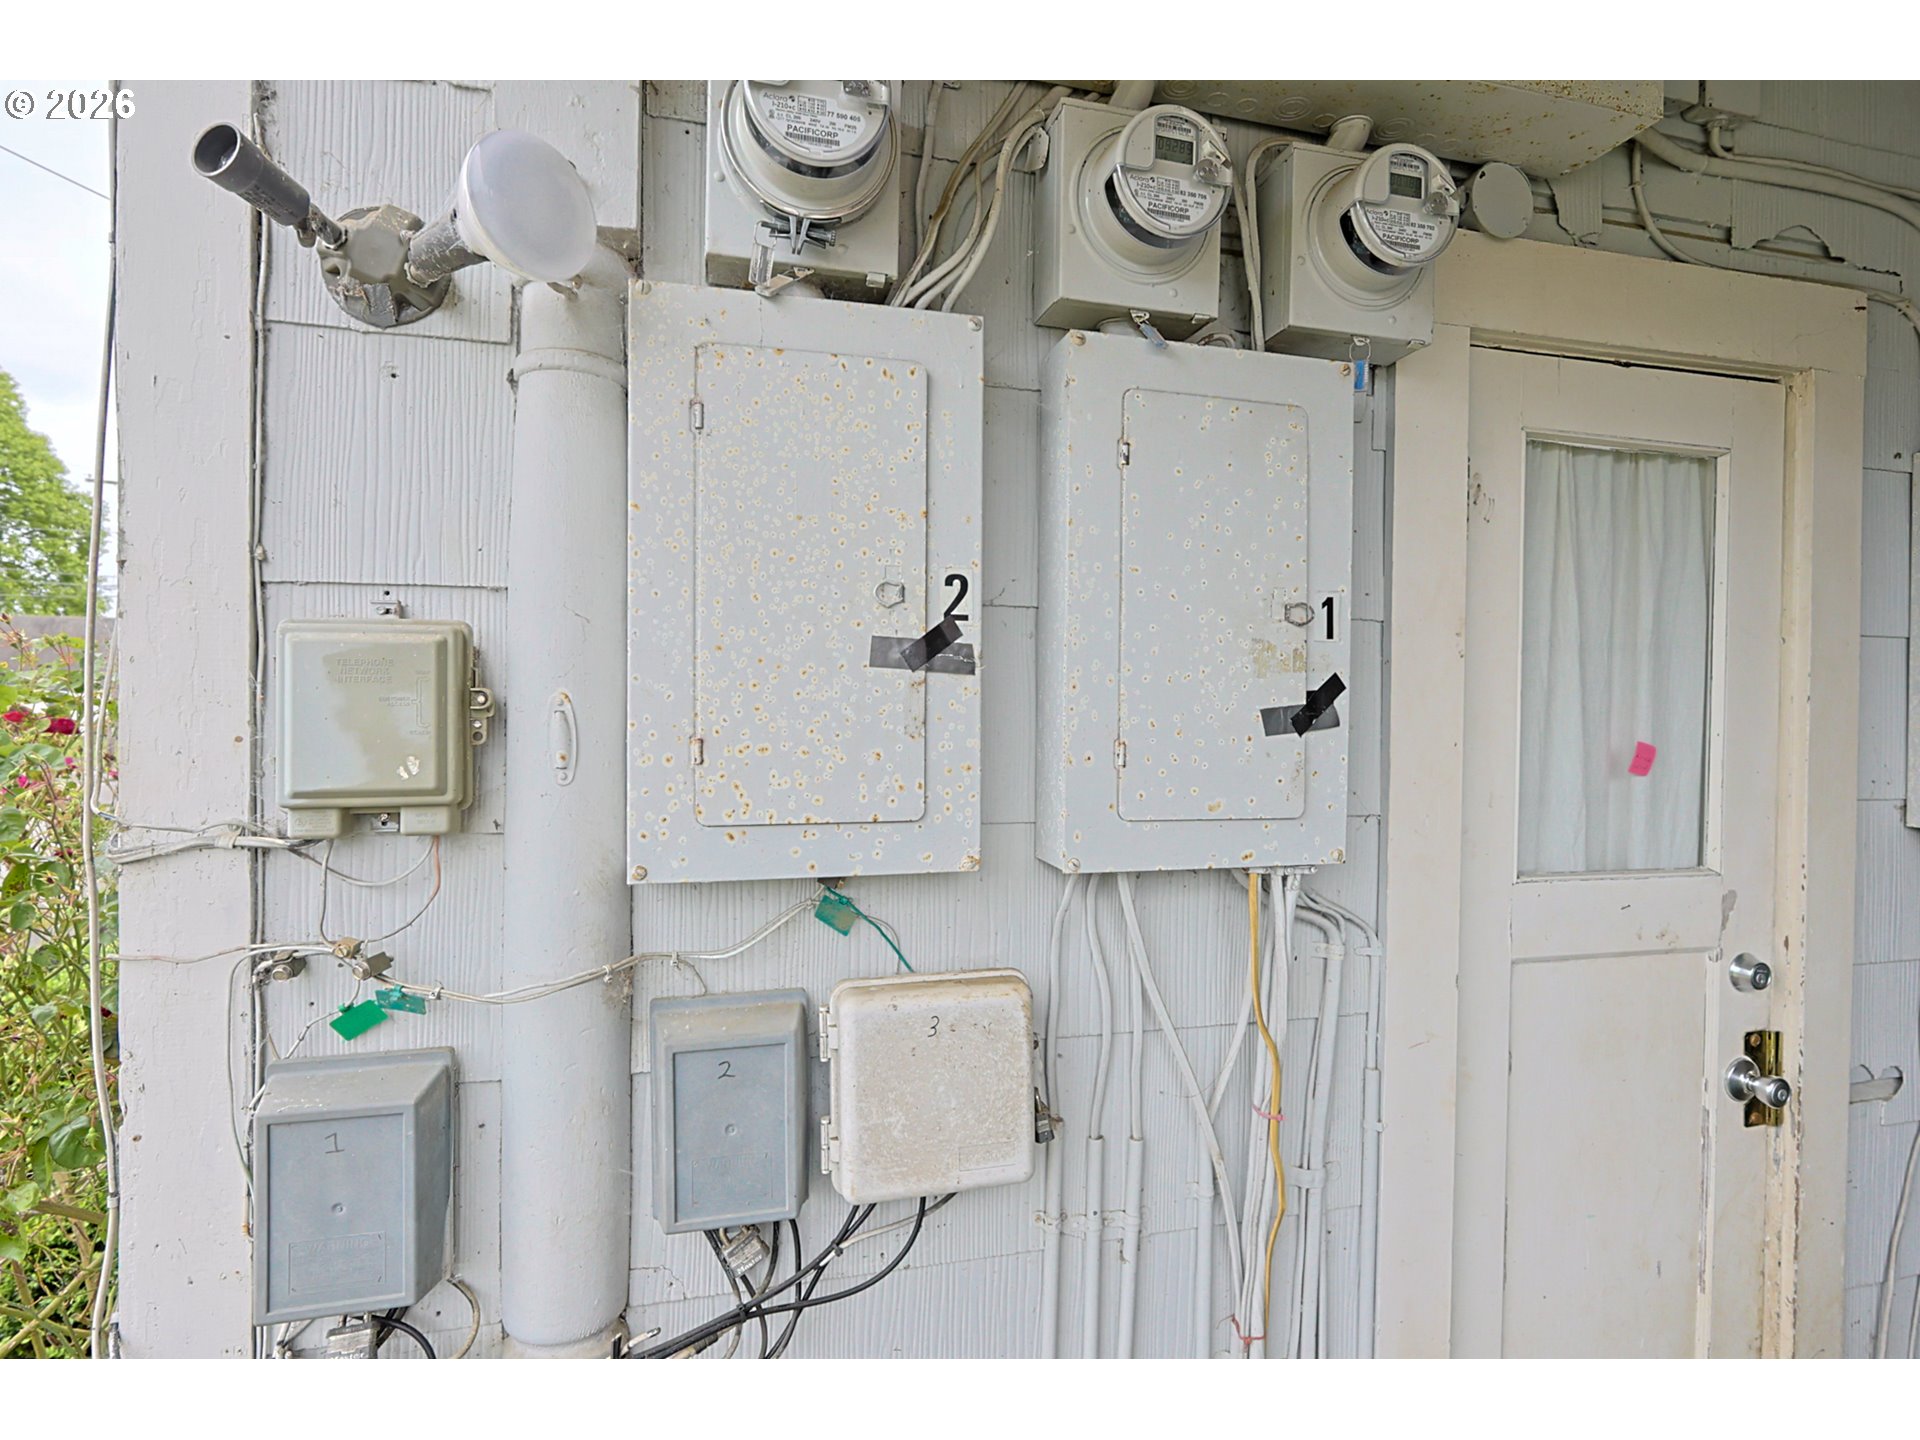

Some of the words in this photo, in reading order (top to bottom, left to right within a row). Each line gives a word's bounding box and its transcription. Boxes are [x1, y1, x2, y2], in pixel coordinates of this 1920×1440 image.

[763, 92, 789, 103] Aclora
[826, 110, 835, 118] 77
[786, 123, 839, 139] PACIFICORP
[1147, 201, 1190, 214] PACIFICORP
[1382, 233, 1420, 245] PACIFICORP
[943, 573, 969, 622] 2
[1321, 597, 1334, 640] 1
[336, 657, 395, 668] TELEPHONE
[339, 667, 392, 676] NETWORK
[336, 675, 393, 685] INTERFACE
[927, 1015, 940, 1038] 3
[717, 1060, 736, 1080] 2
[324, 1132, 345, 1154] 1
[736, 1254, 763, 1275] Master
